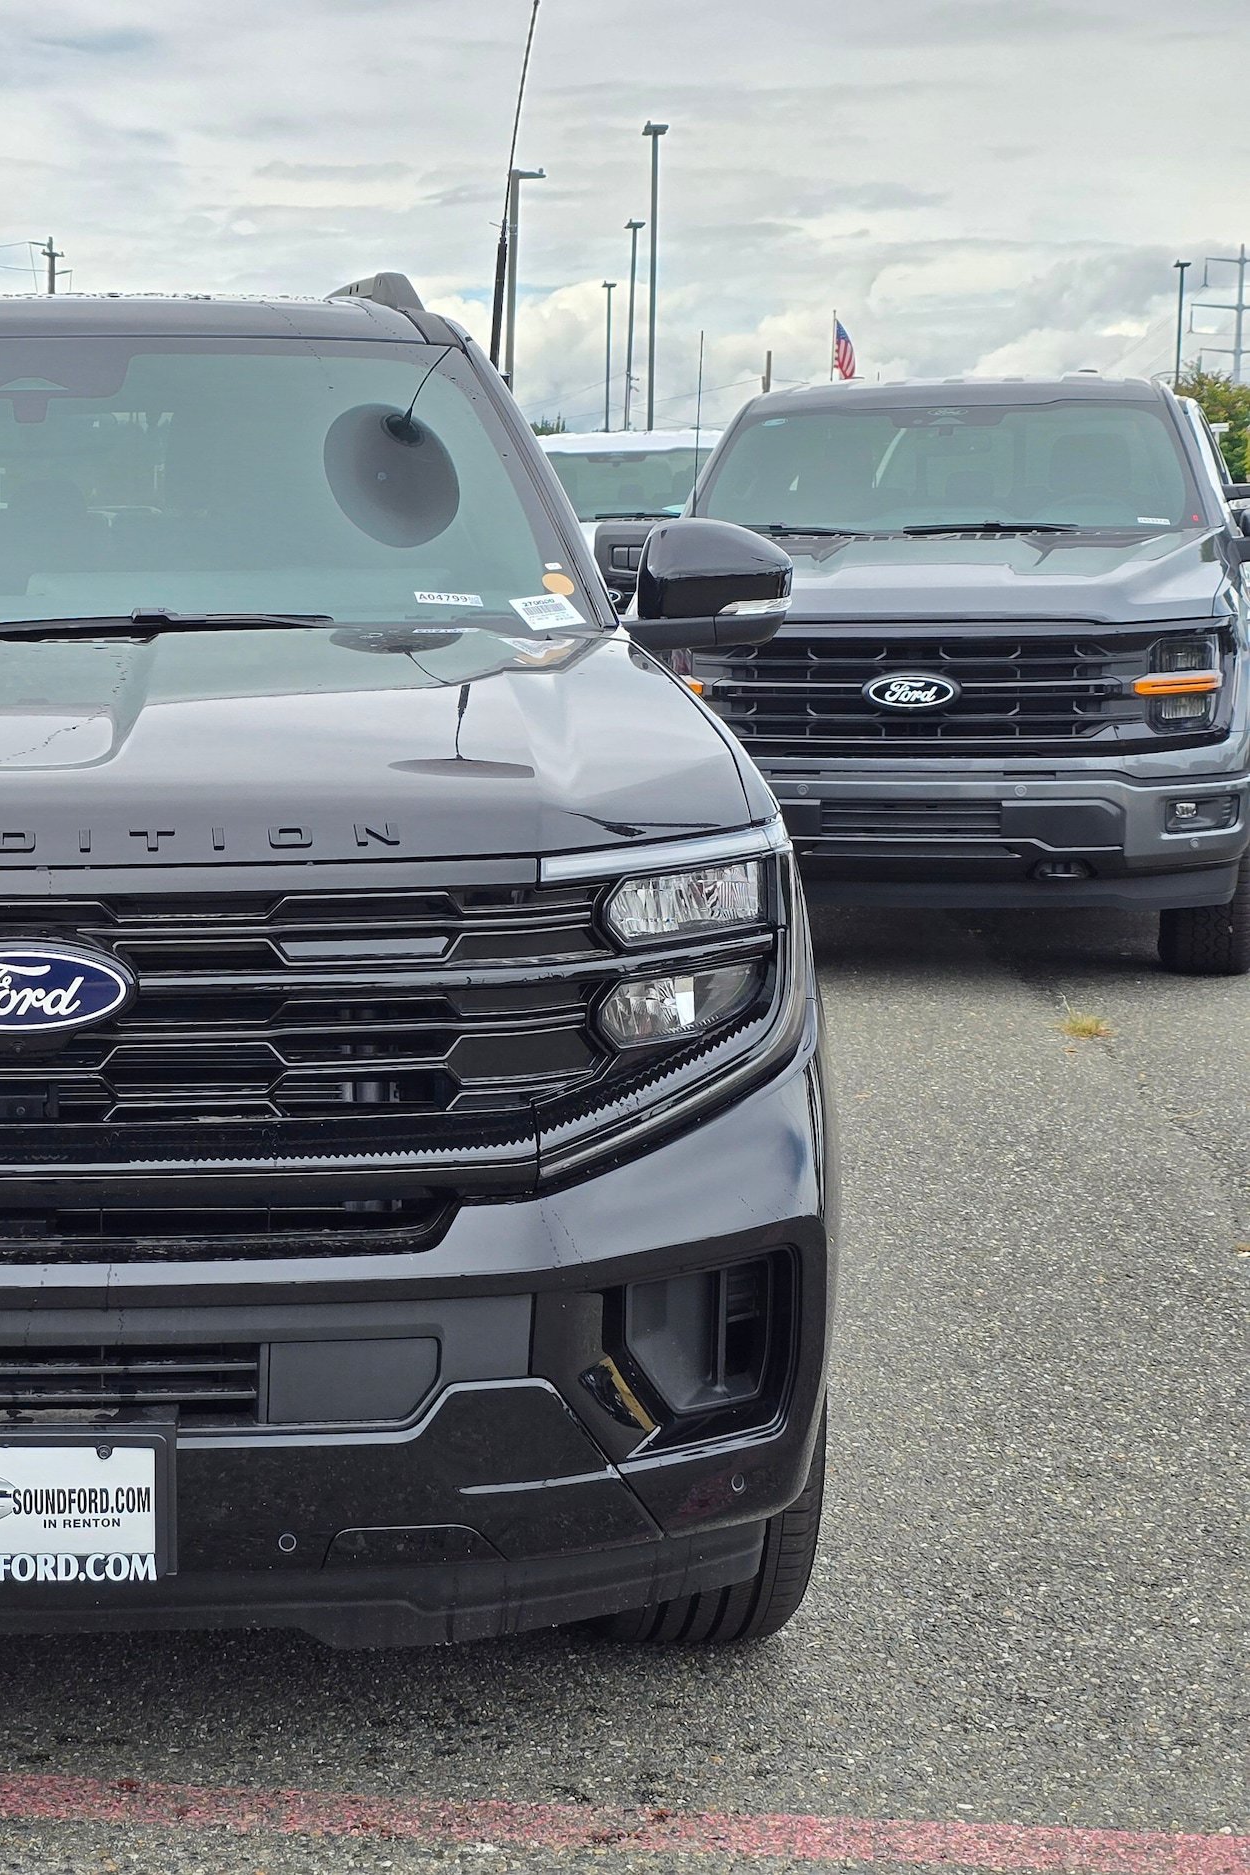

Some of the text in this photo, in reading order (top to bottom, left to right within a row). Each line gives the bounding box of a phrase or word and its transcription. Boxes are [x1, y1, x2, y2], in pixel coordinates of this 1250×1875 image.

[884, 680, 938, 702] Ford
[12, 1486, 151, 1515] SOUNDFORD.COM
[43, 1517, 121, 1529] IN RENTON
